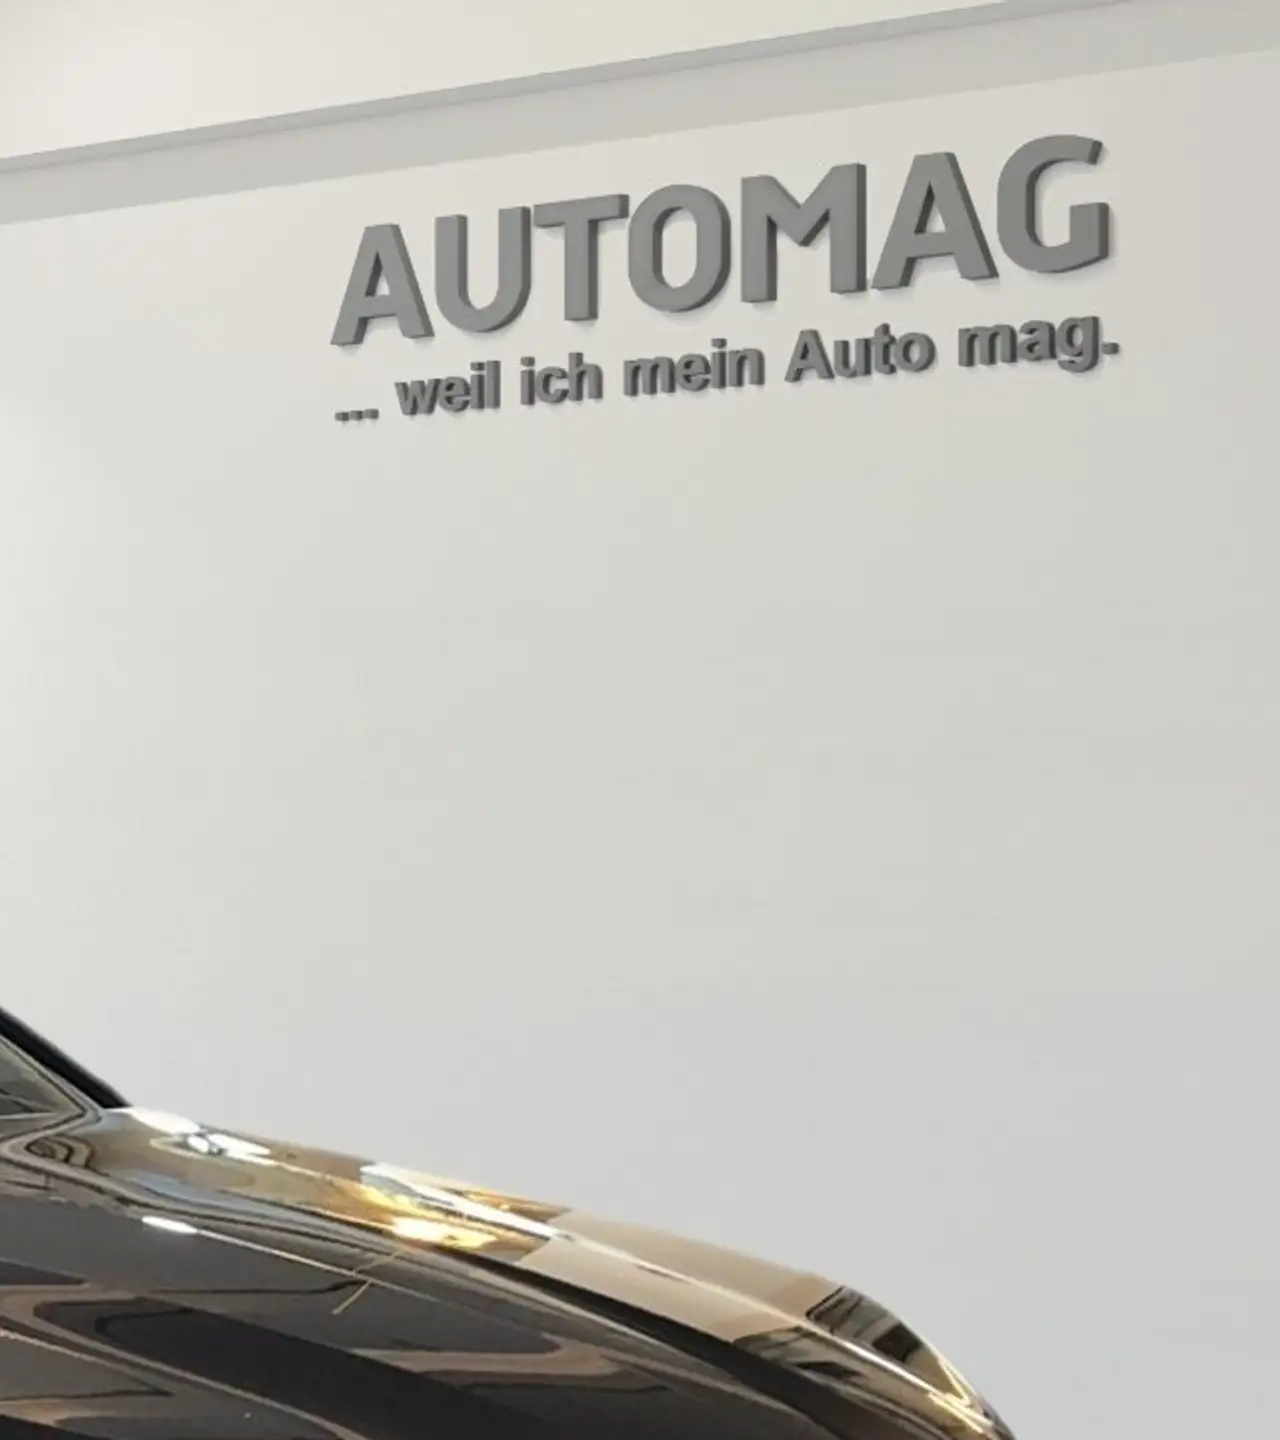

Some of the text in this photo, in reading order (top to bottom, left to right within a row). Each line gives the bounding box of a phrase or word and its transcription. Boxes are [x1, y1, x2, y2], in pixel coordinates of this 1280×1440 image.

[329, 134, 1110, 346] AUTOMAG
[394, 359, 501, 416] weil
[520, 351, 604, 405] ich
[623, 338, 766, 397] mein
[784, 322, 938, 383] Auto
[958, 315, 1120, 374] mag.
